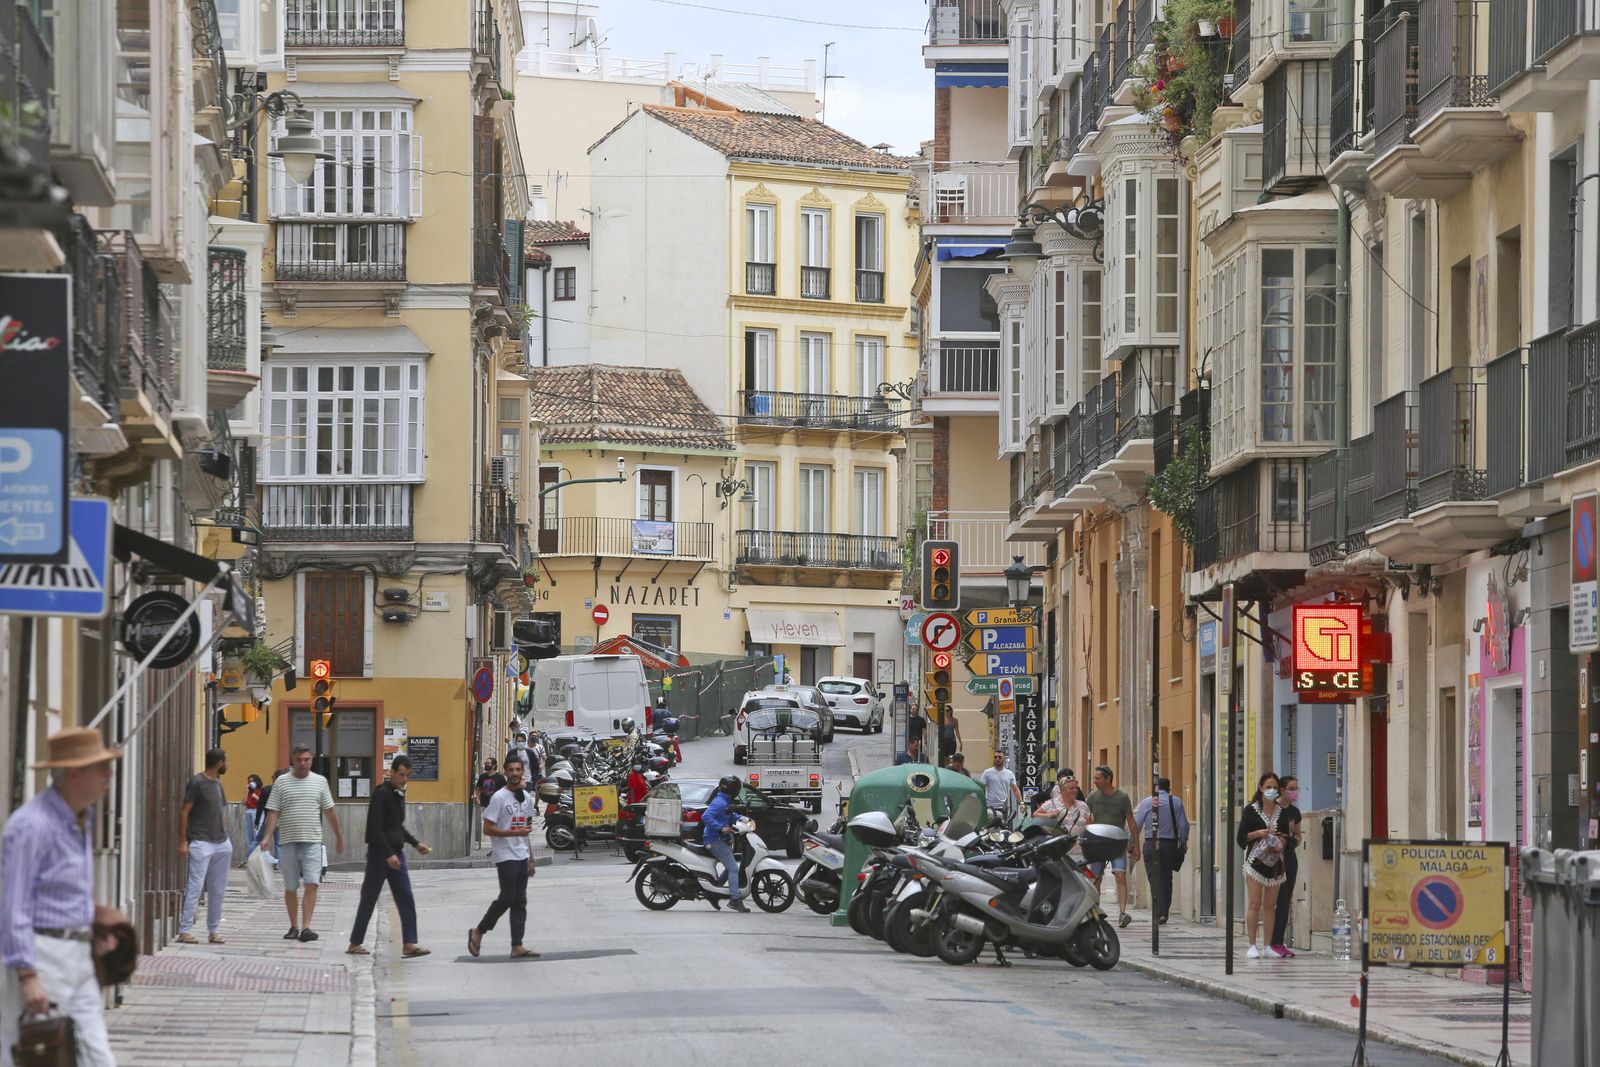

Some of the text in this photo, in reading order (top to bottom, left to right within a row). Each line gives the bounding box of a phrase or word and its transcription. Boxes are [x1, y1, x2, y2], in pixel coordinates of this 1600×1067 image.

[610, 585, 700, 606] NAZARET
[983, 629, 1026, 650] P ALCAZABA
[987, 654, 1026, 674] P TEJÓN
[1026, 693, 1037, 787] LAGATRON
[1401, 848, 1487, 860] POLICIA LOCAL
[1419, 861, 1469, 873] MALAGA
[1372, 933, 1416, 945] PROHIBIDO
[1420, 934, 1470, 946] ESTACIONAR
[1372, 948, 1388, 959] LAS
[1428, 949, 1444, 960] DEL
[1465, 948, 1472, 959] 4
[1487, 948, 1495, 961] 8
